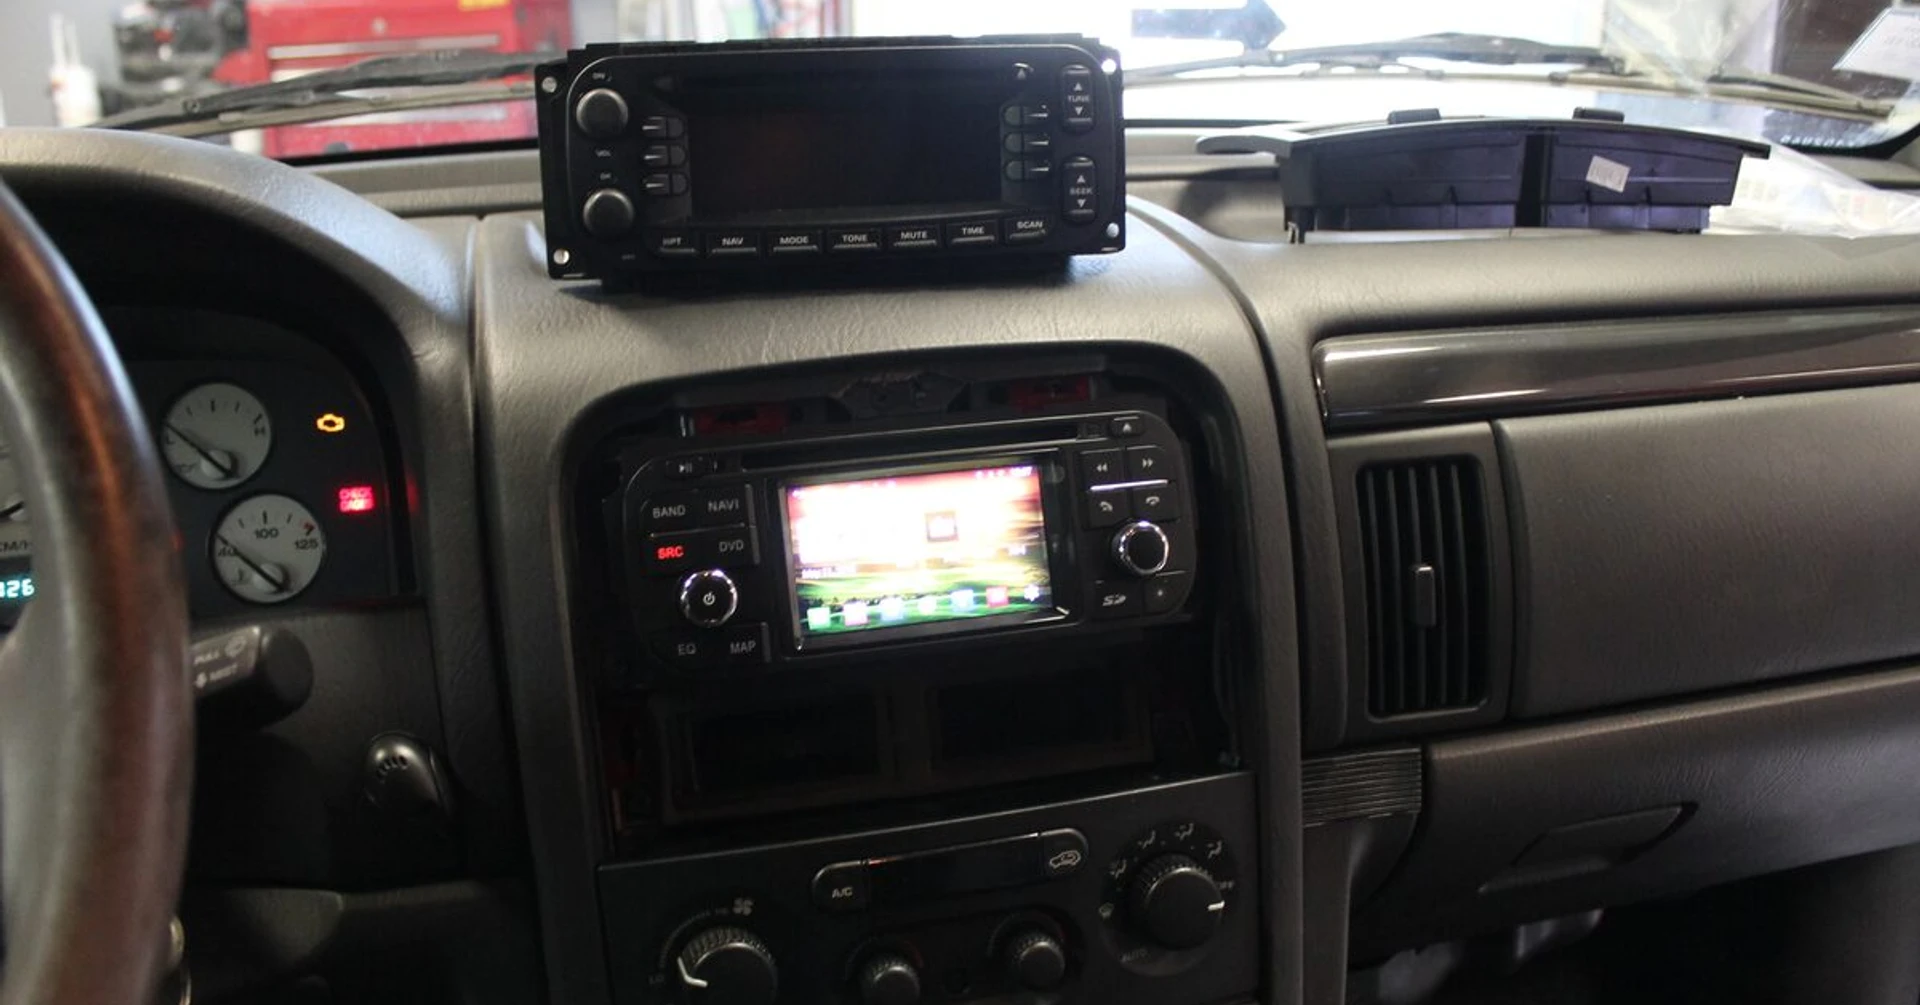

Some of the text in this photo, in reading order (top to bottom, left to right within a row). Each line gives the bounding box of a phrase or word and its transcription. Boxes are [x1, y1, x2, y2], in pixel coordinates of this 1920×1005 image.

[1069, 187, 1093, 196] SEEK
[961, 226, 985, 236] TIME
[1017, 220, 1043, 230] SCAN
[721, 237, 744, 246] NAV
[779, 235, 808, 245] MODE
[842, 234, 868, 243] TONE
[901, 230, 928, 241] MUTE
[652, 504, 686, 519] BAND
[707, 498, 740, 513] NAVI
[254, 528, 280, 540] 100
[294, 538, 319, 550] 125
[719, 539, 745, 553] DVD
[657, 545, 685, 560] SRC
[677, 642, 698, 657] EQ
[729, 640, 757, 655] MAP
[831, 886, 853, 899] A/C
